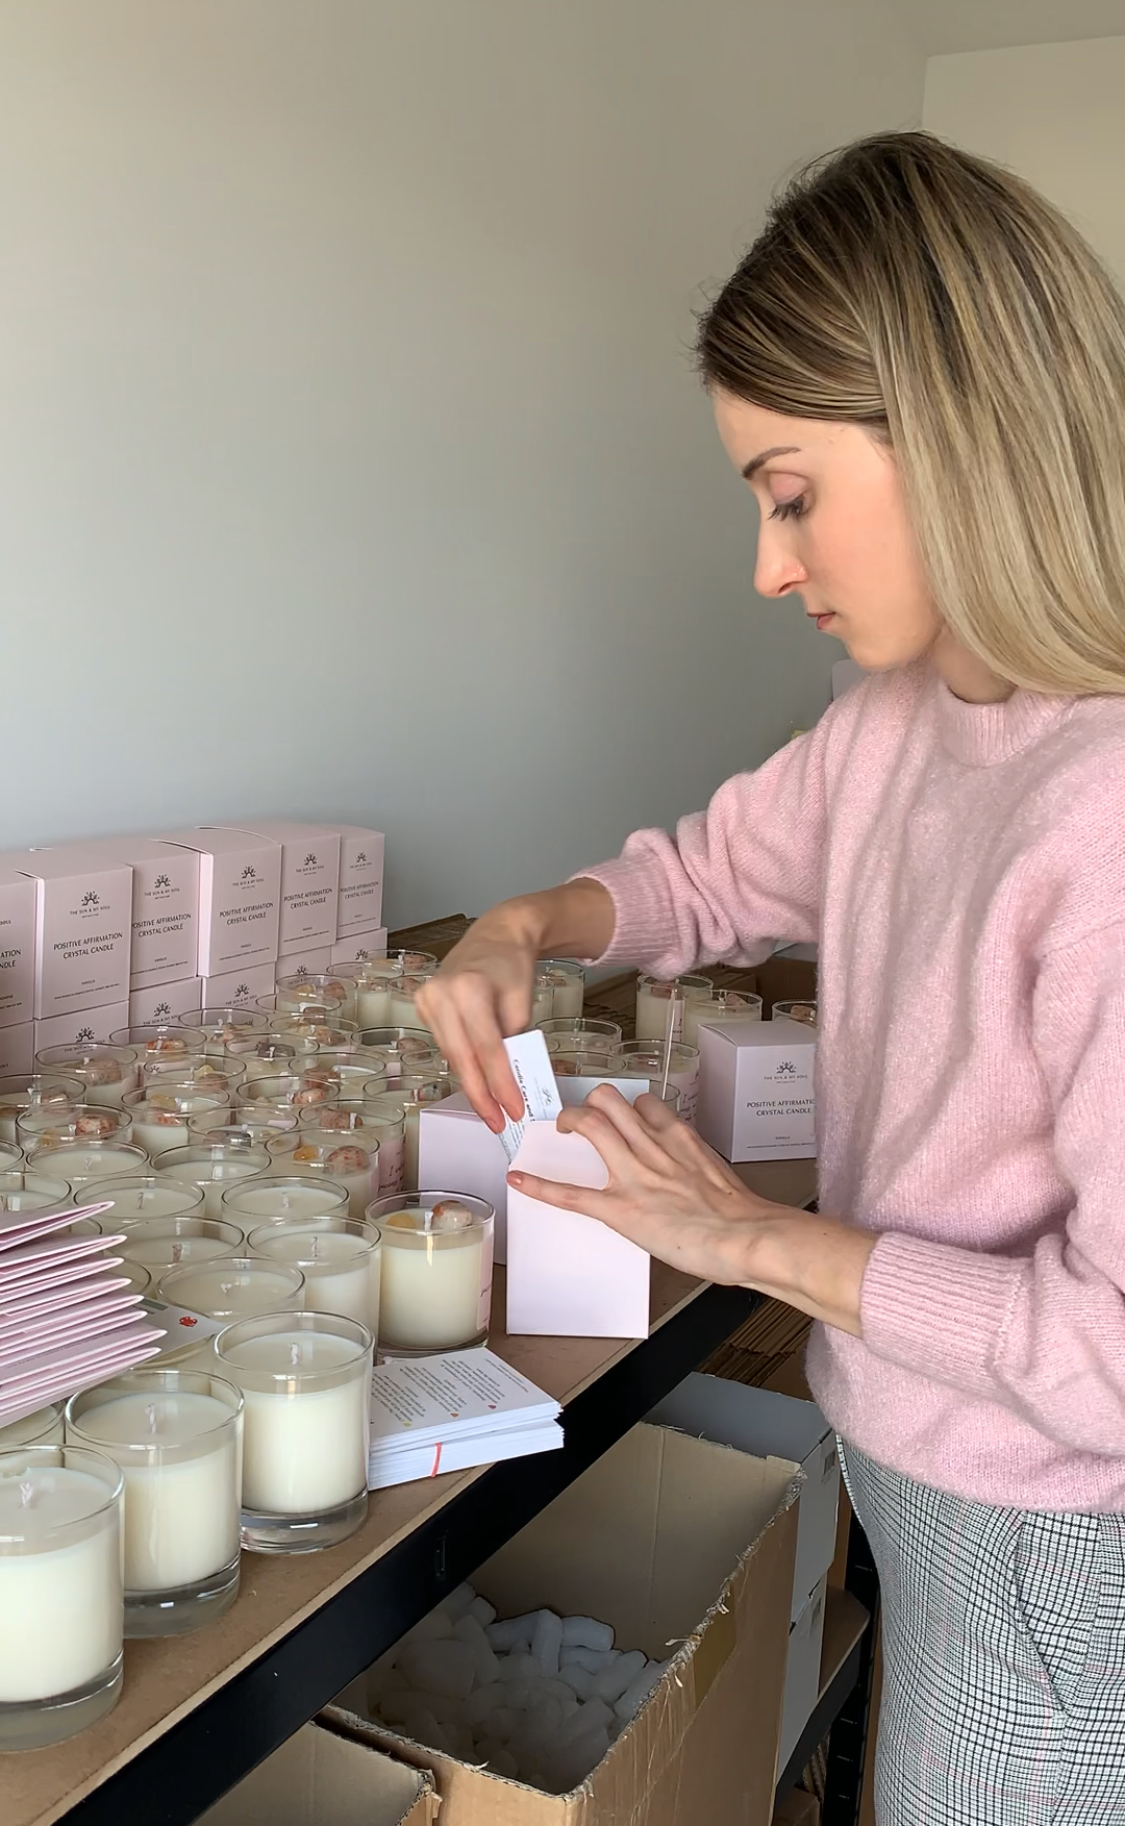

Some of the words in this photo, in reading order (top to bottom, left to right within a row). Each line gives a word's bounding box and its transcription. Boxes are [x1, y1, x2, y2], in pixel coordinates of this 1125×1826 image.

[284, 893, 304, 902] POSITIVE
[304, 888, 333, 898] AFFIRMATION
[220, 908, 242, 917] POSITIVE
[242, 902, 274, 913] AFFIRMATION
[290, 900, 309, 909] CRYSTAL
[310, 897, 326, 905] CANDLE
[156, 914, 191, 924] AFFIRMATION
[226, 916, 248, 925] CRYSTAL
[248, 912, 266, 921] CANDLE
[138, 928, 162, 938] CRYSTAL
[163, 924, 183, 933] CANDLE
[53, 940, 82, 950] POSITIVE
[83, 932, 123, 945] AFFIRMATION
[0, 949, 21, 959] ATION
[63, 948, 89, 959] CRYSTAL
[90, 944, 114, 954] CANDLE
[526, 1104, 534, 1118] and
